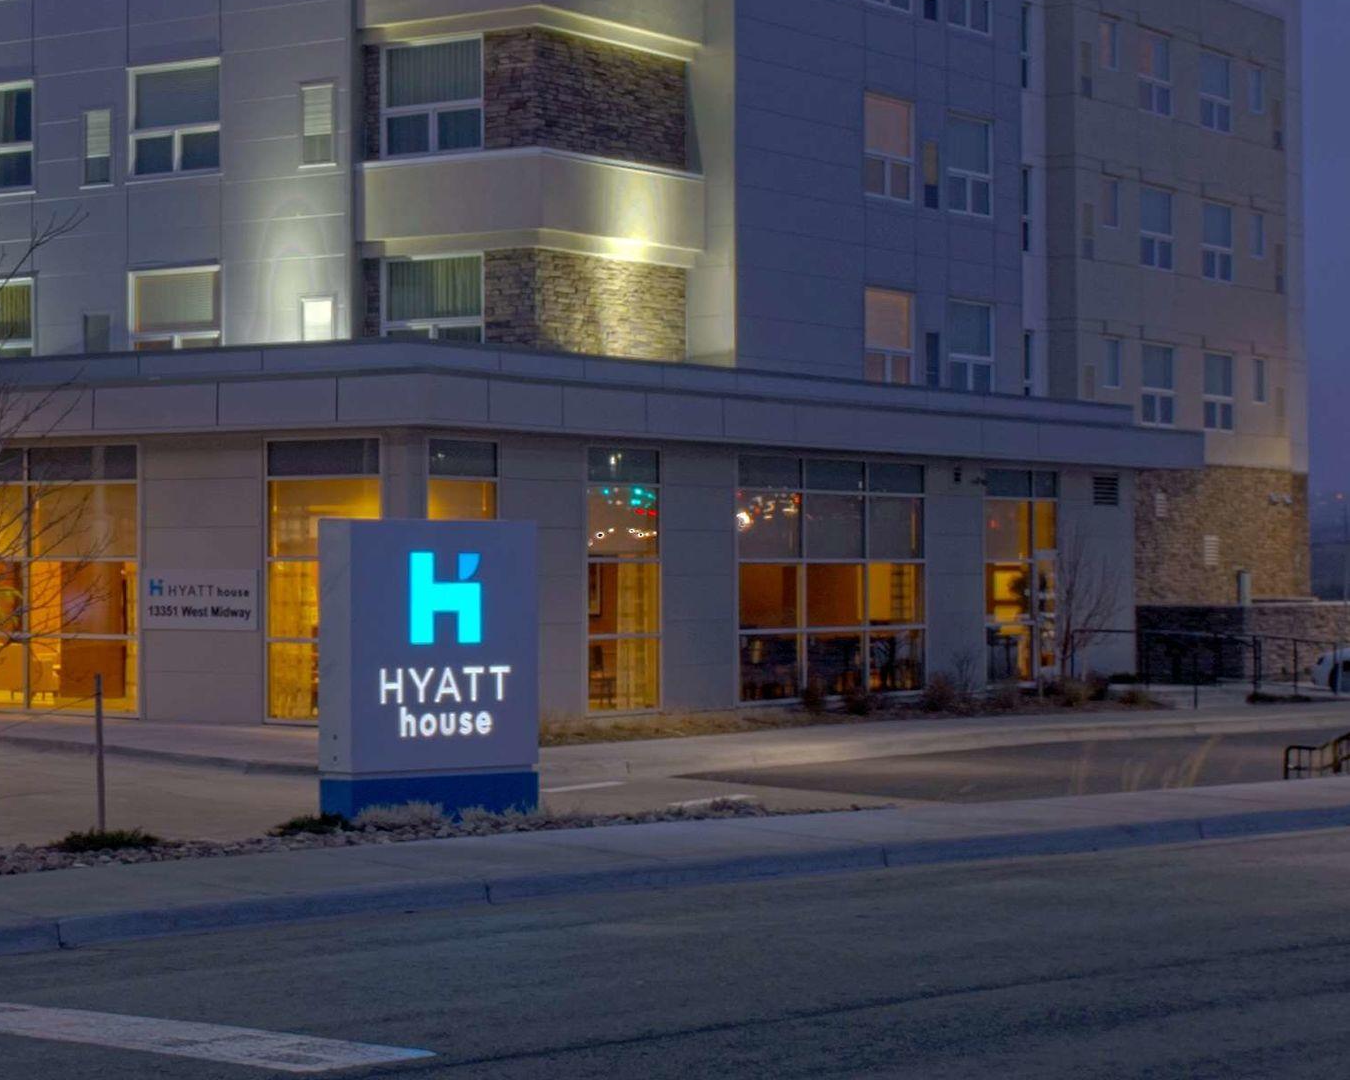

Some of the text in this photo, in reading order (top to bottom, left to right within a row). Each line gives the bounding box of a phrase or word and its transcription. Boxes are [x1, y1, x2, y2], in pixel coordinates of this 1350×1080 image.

[168, 584, 214, 597] HYATT
[217, 586, 250, 598] house
[149, 605, 252, 620] 13351 West Midway
[379, 665, 511, 705] HYATT
[399, 706, 493, 738] house
